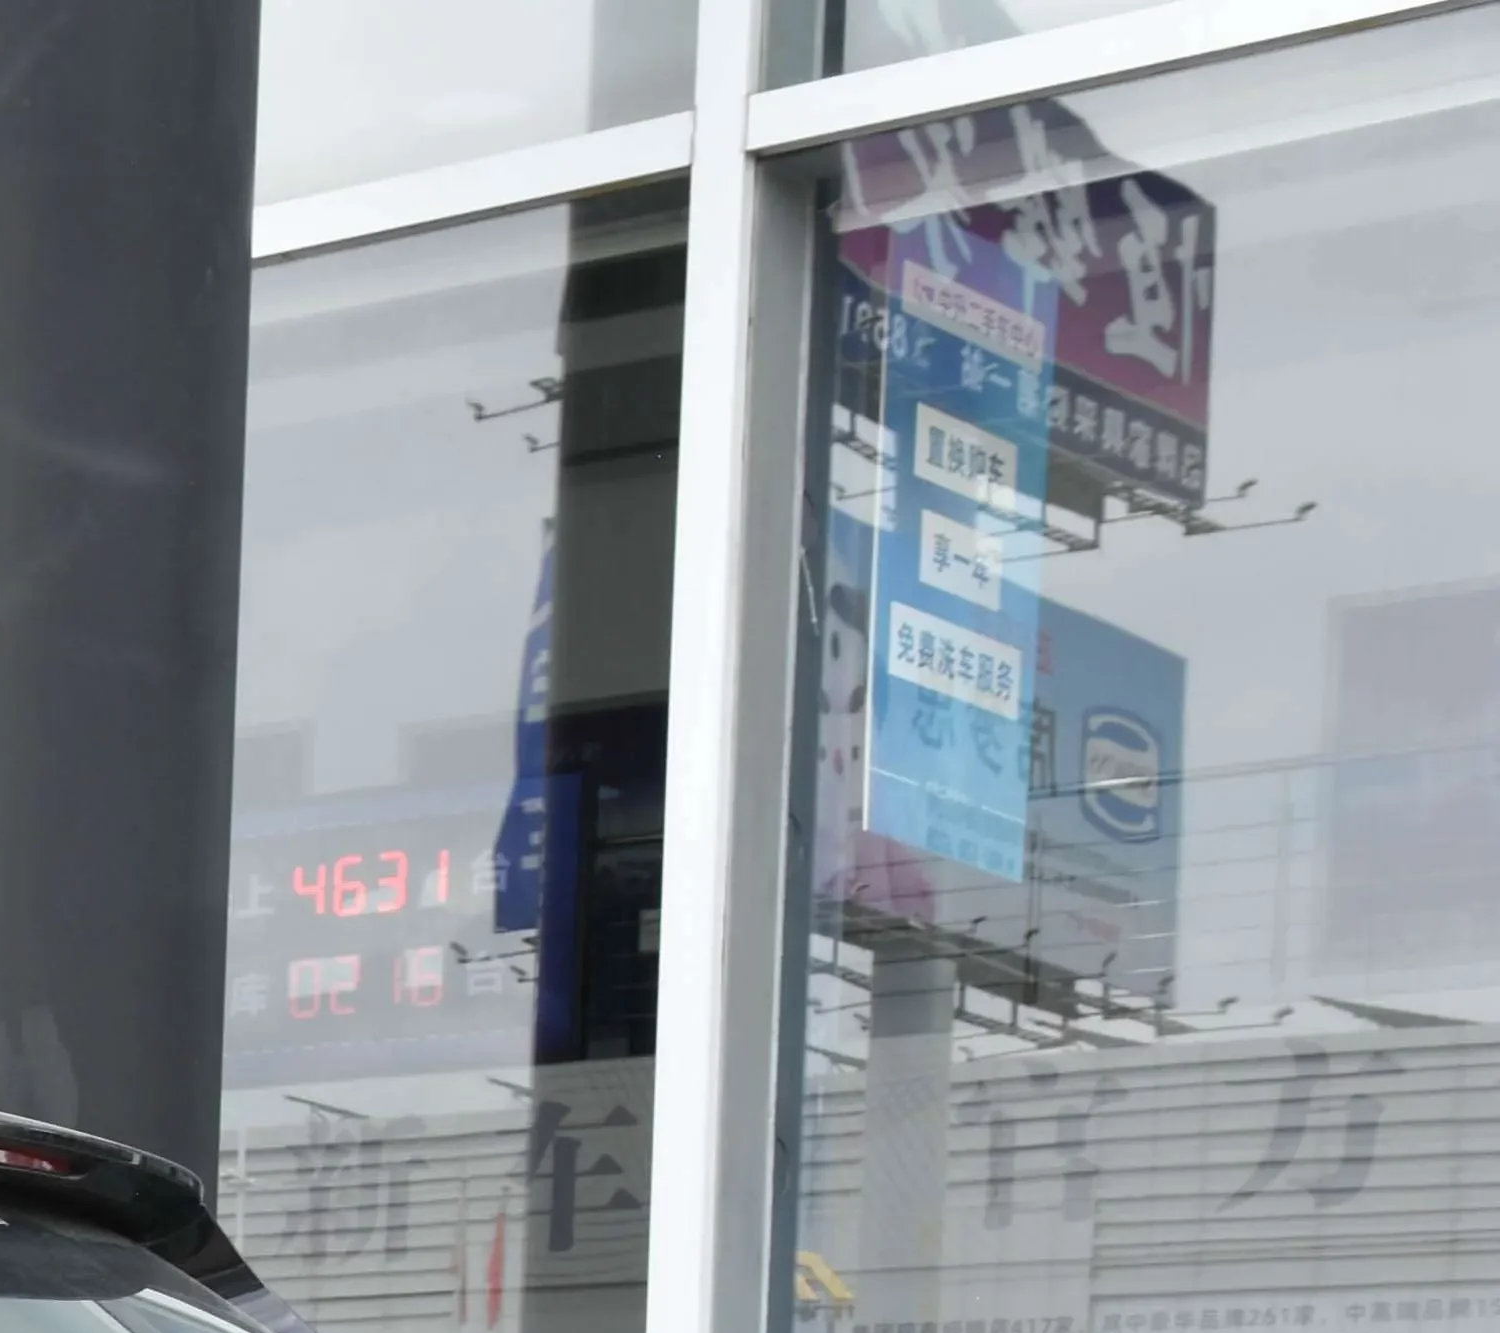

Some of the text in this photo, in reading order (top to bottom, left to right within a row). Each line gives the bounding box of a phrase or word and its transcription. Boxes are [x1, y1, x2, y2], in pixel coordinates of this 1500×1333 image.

[895, 620, 1014, 705] 免费洗车服务
[293, 849, 451, 917] 4631
